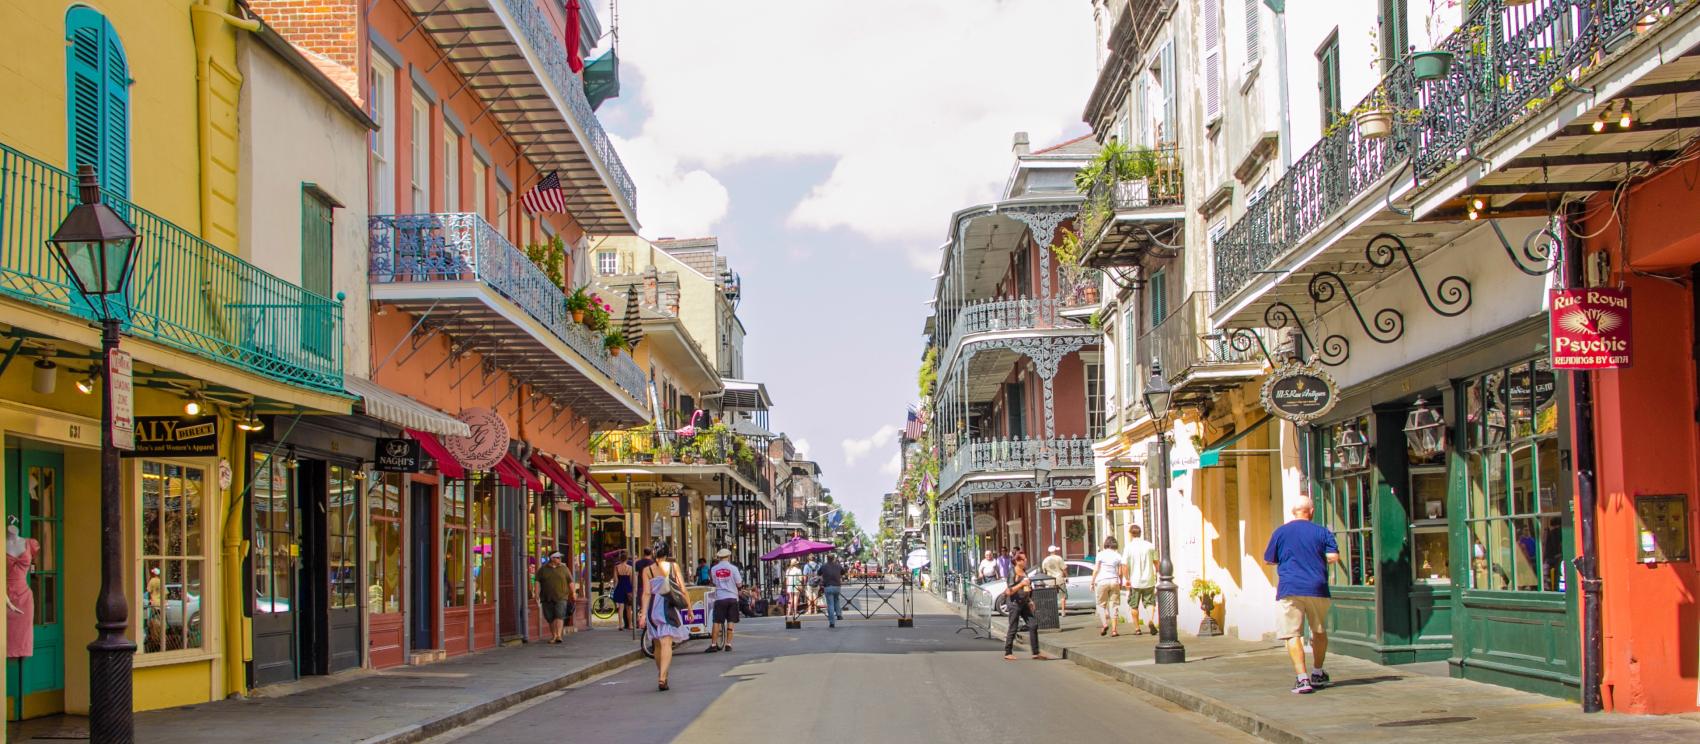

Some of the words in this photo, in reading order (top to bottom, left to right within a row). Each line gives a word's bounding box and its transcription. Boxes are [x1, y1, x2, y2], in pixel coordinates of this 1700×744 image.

[1554, 295, 1582, 310] Rue
[1587, 291, 1628, 309] Royal
[1555, 336, 1627, 354] Psychic
[1554, 355, 1594, 365] READINGS
[1596, 355, 1607, 364] BY
[1608, 355, 1629, 364] GINA
[135, 420, 180, 442] ALY
[179, 425, 212, 438] DIRECT
[192, 444, 215, 452] Apparel
[379, 456, 415, 466] NAGHI'S
